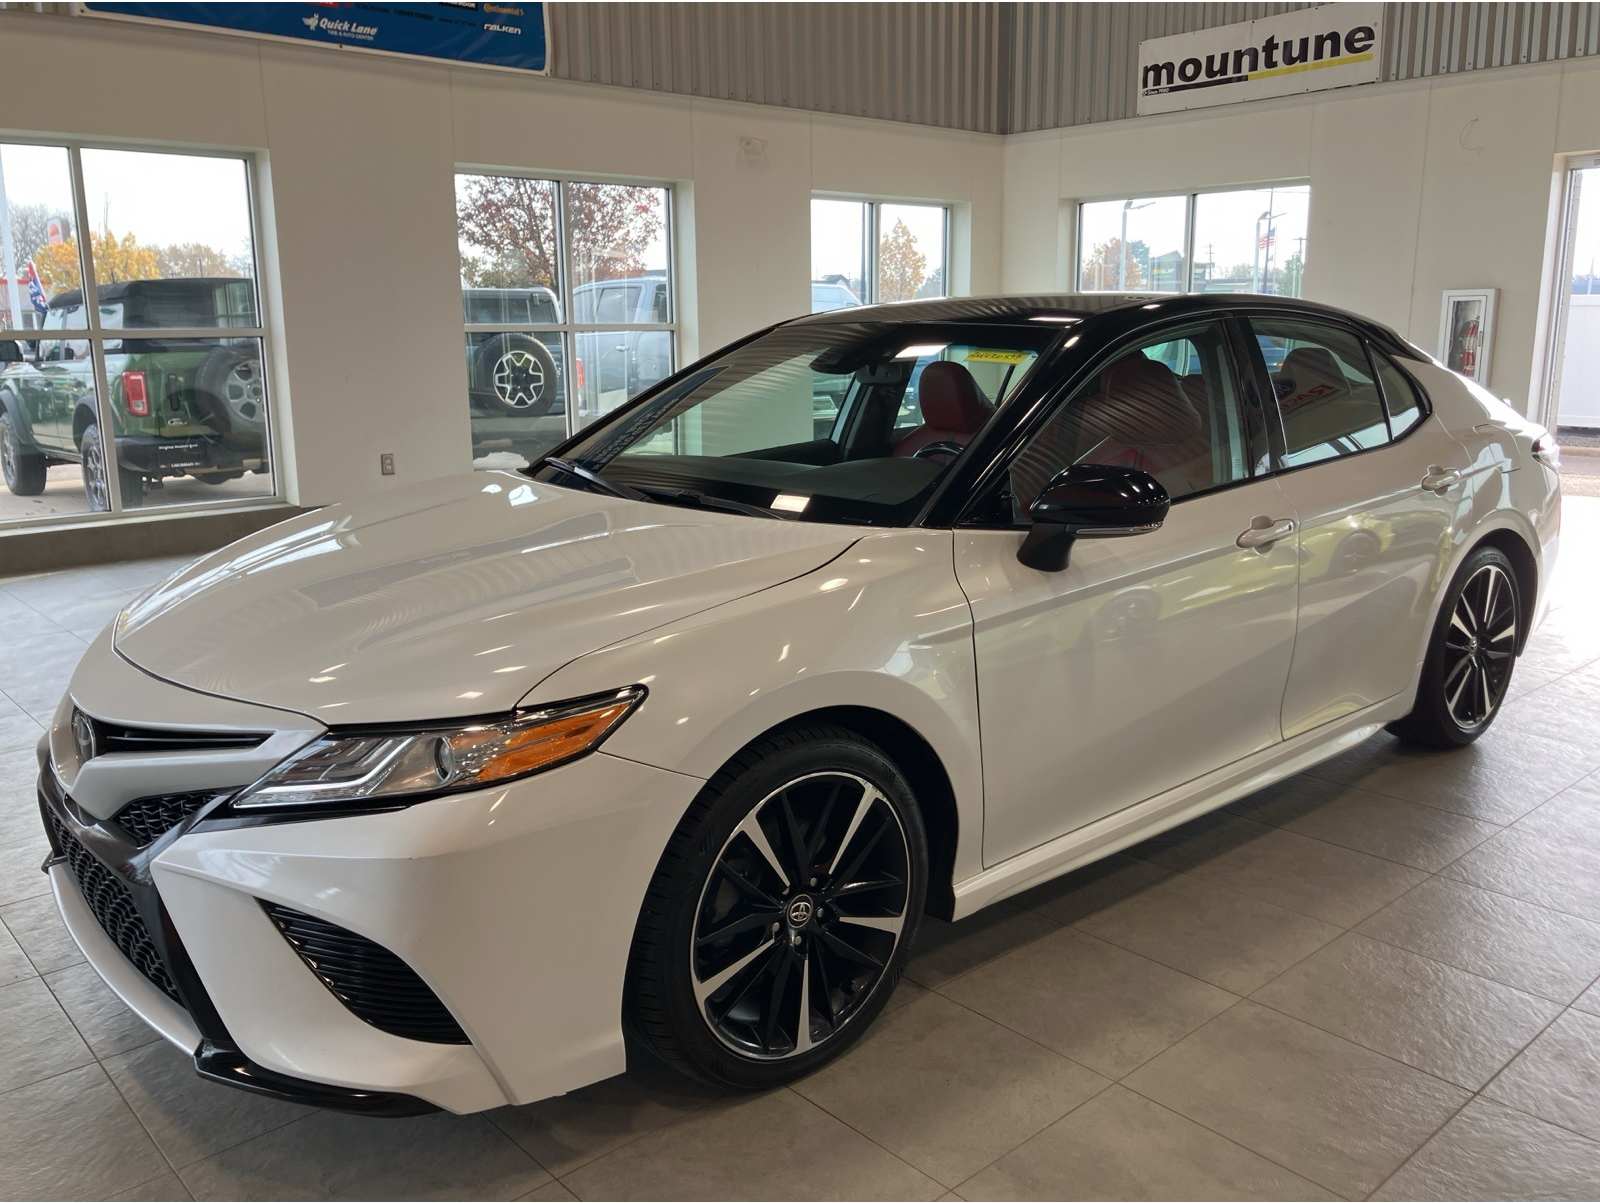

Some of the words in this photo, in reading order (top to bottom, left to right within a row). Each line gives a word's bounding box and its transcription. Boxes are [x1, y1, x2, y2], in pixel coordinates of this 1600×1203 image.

[319, 17, 350, 31] Quick
[351, 22, 379, 36] Lane
[1142, 25, 1375, 88] mountune
